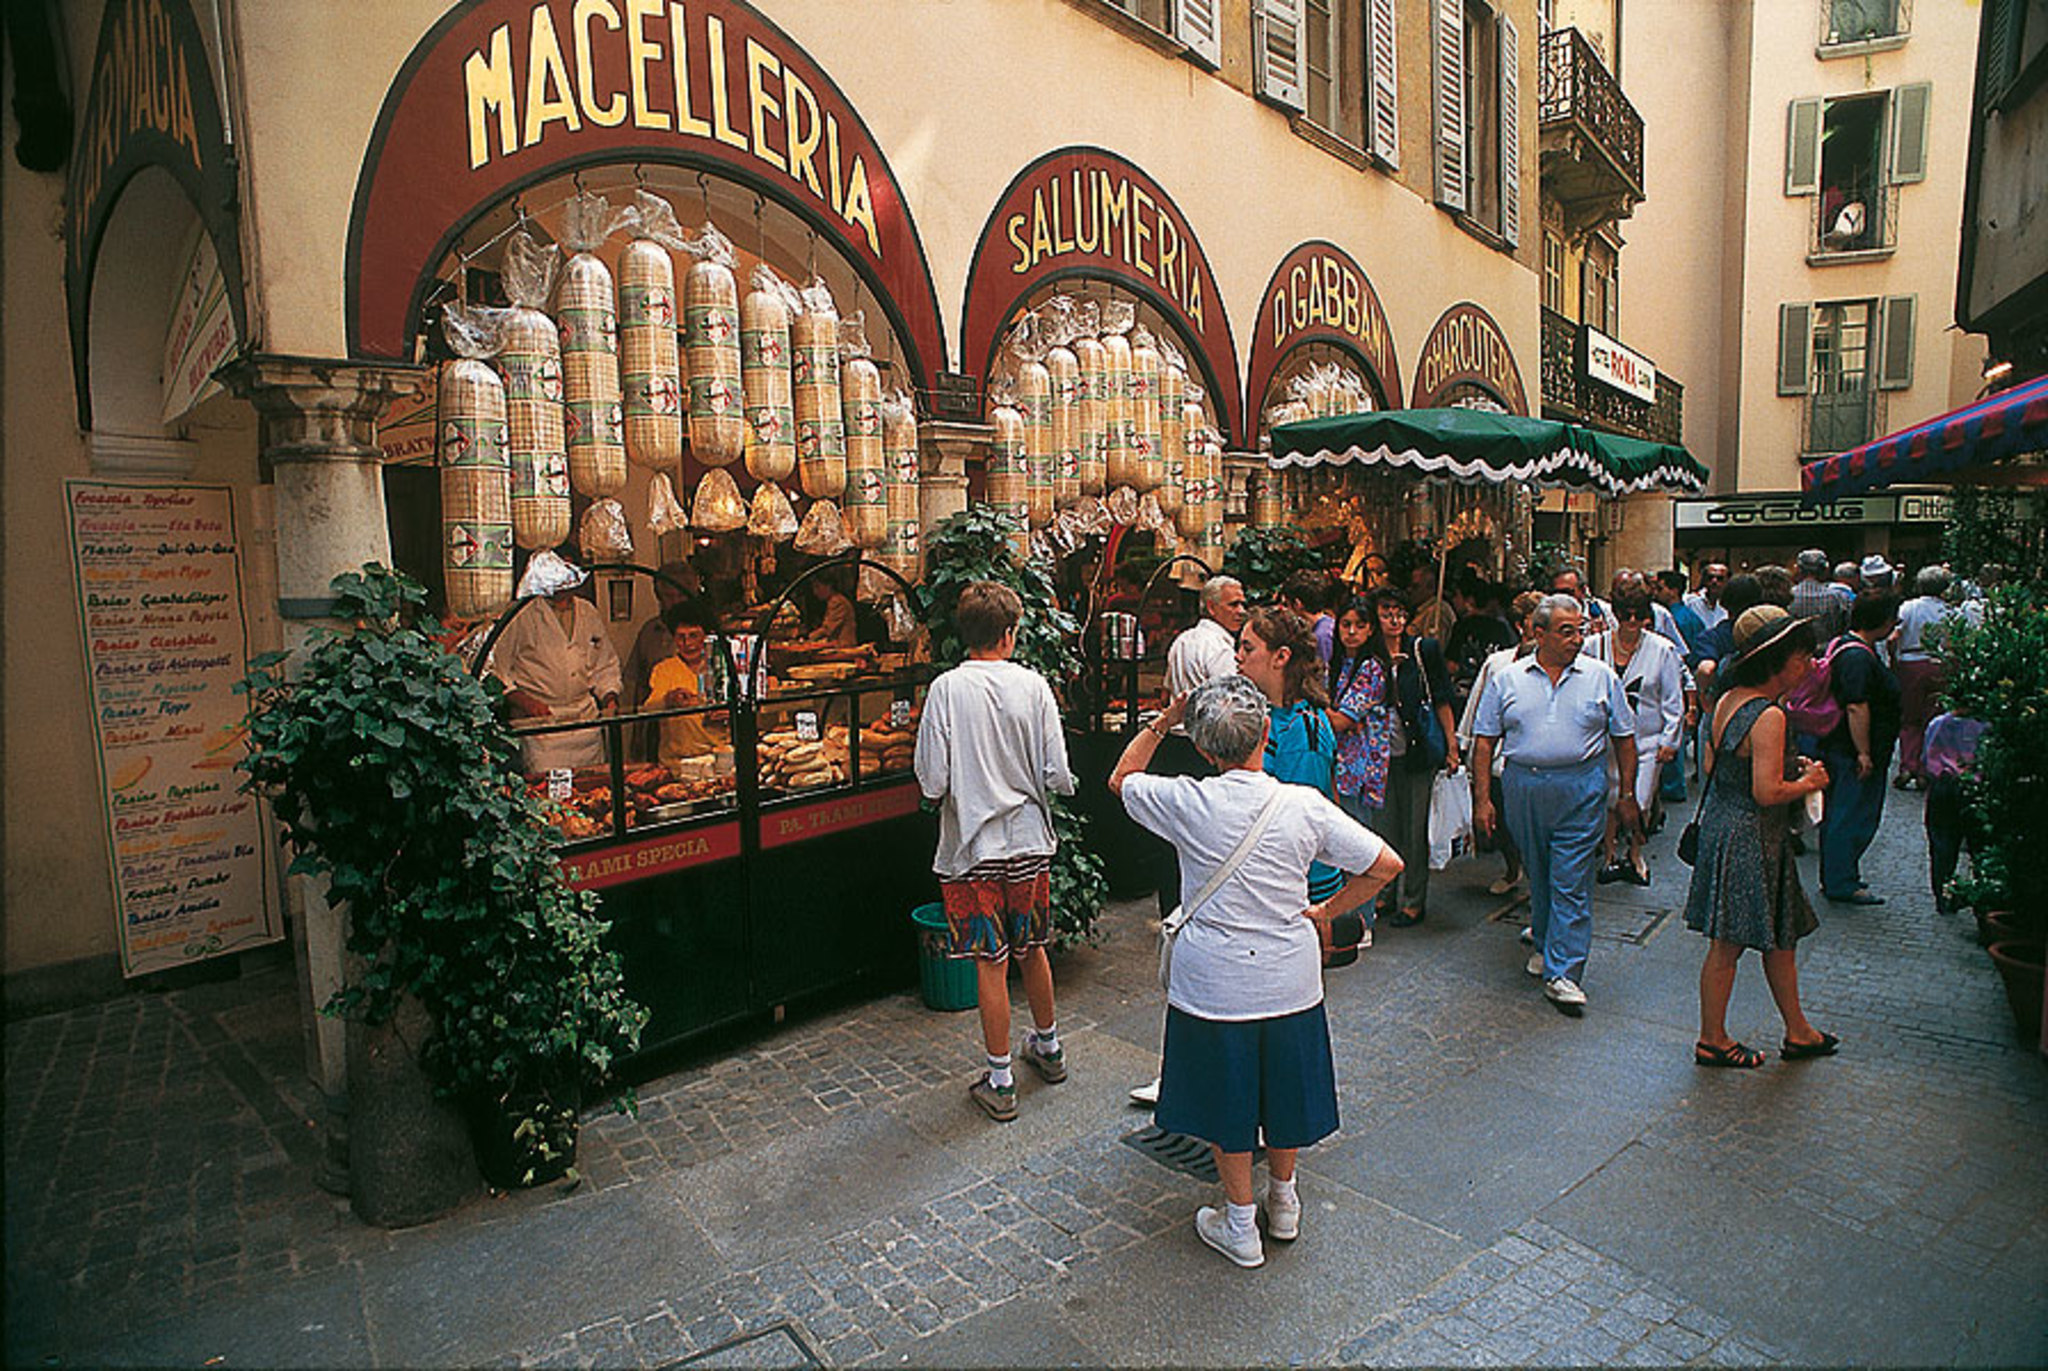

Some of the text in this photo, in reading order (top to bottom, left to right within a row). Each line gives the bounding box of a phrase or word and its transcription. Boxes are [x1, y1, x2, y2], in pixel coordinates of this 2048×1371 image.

[464, 0, 882, 259] MACELLERIA
[1008, 170, 1205, 336] SALUMERIA
[636, 837, 709, 868] SPECIA
